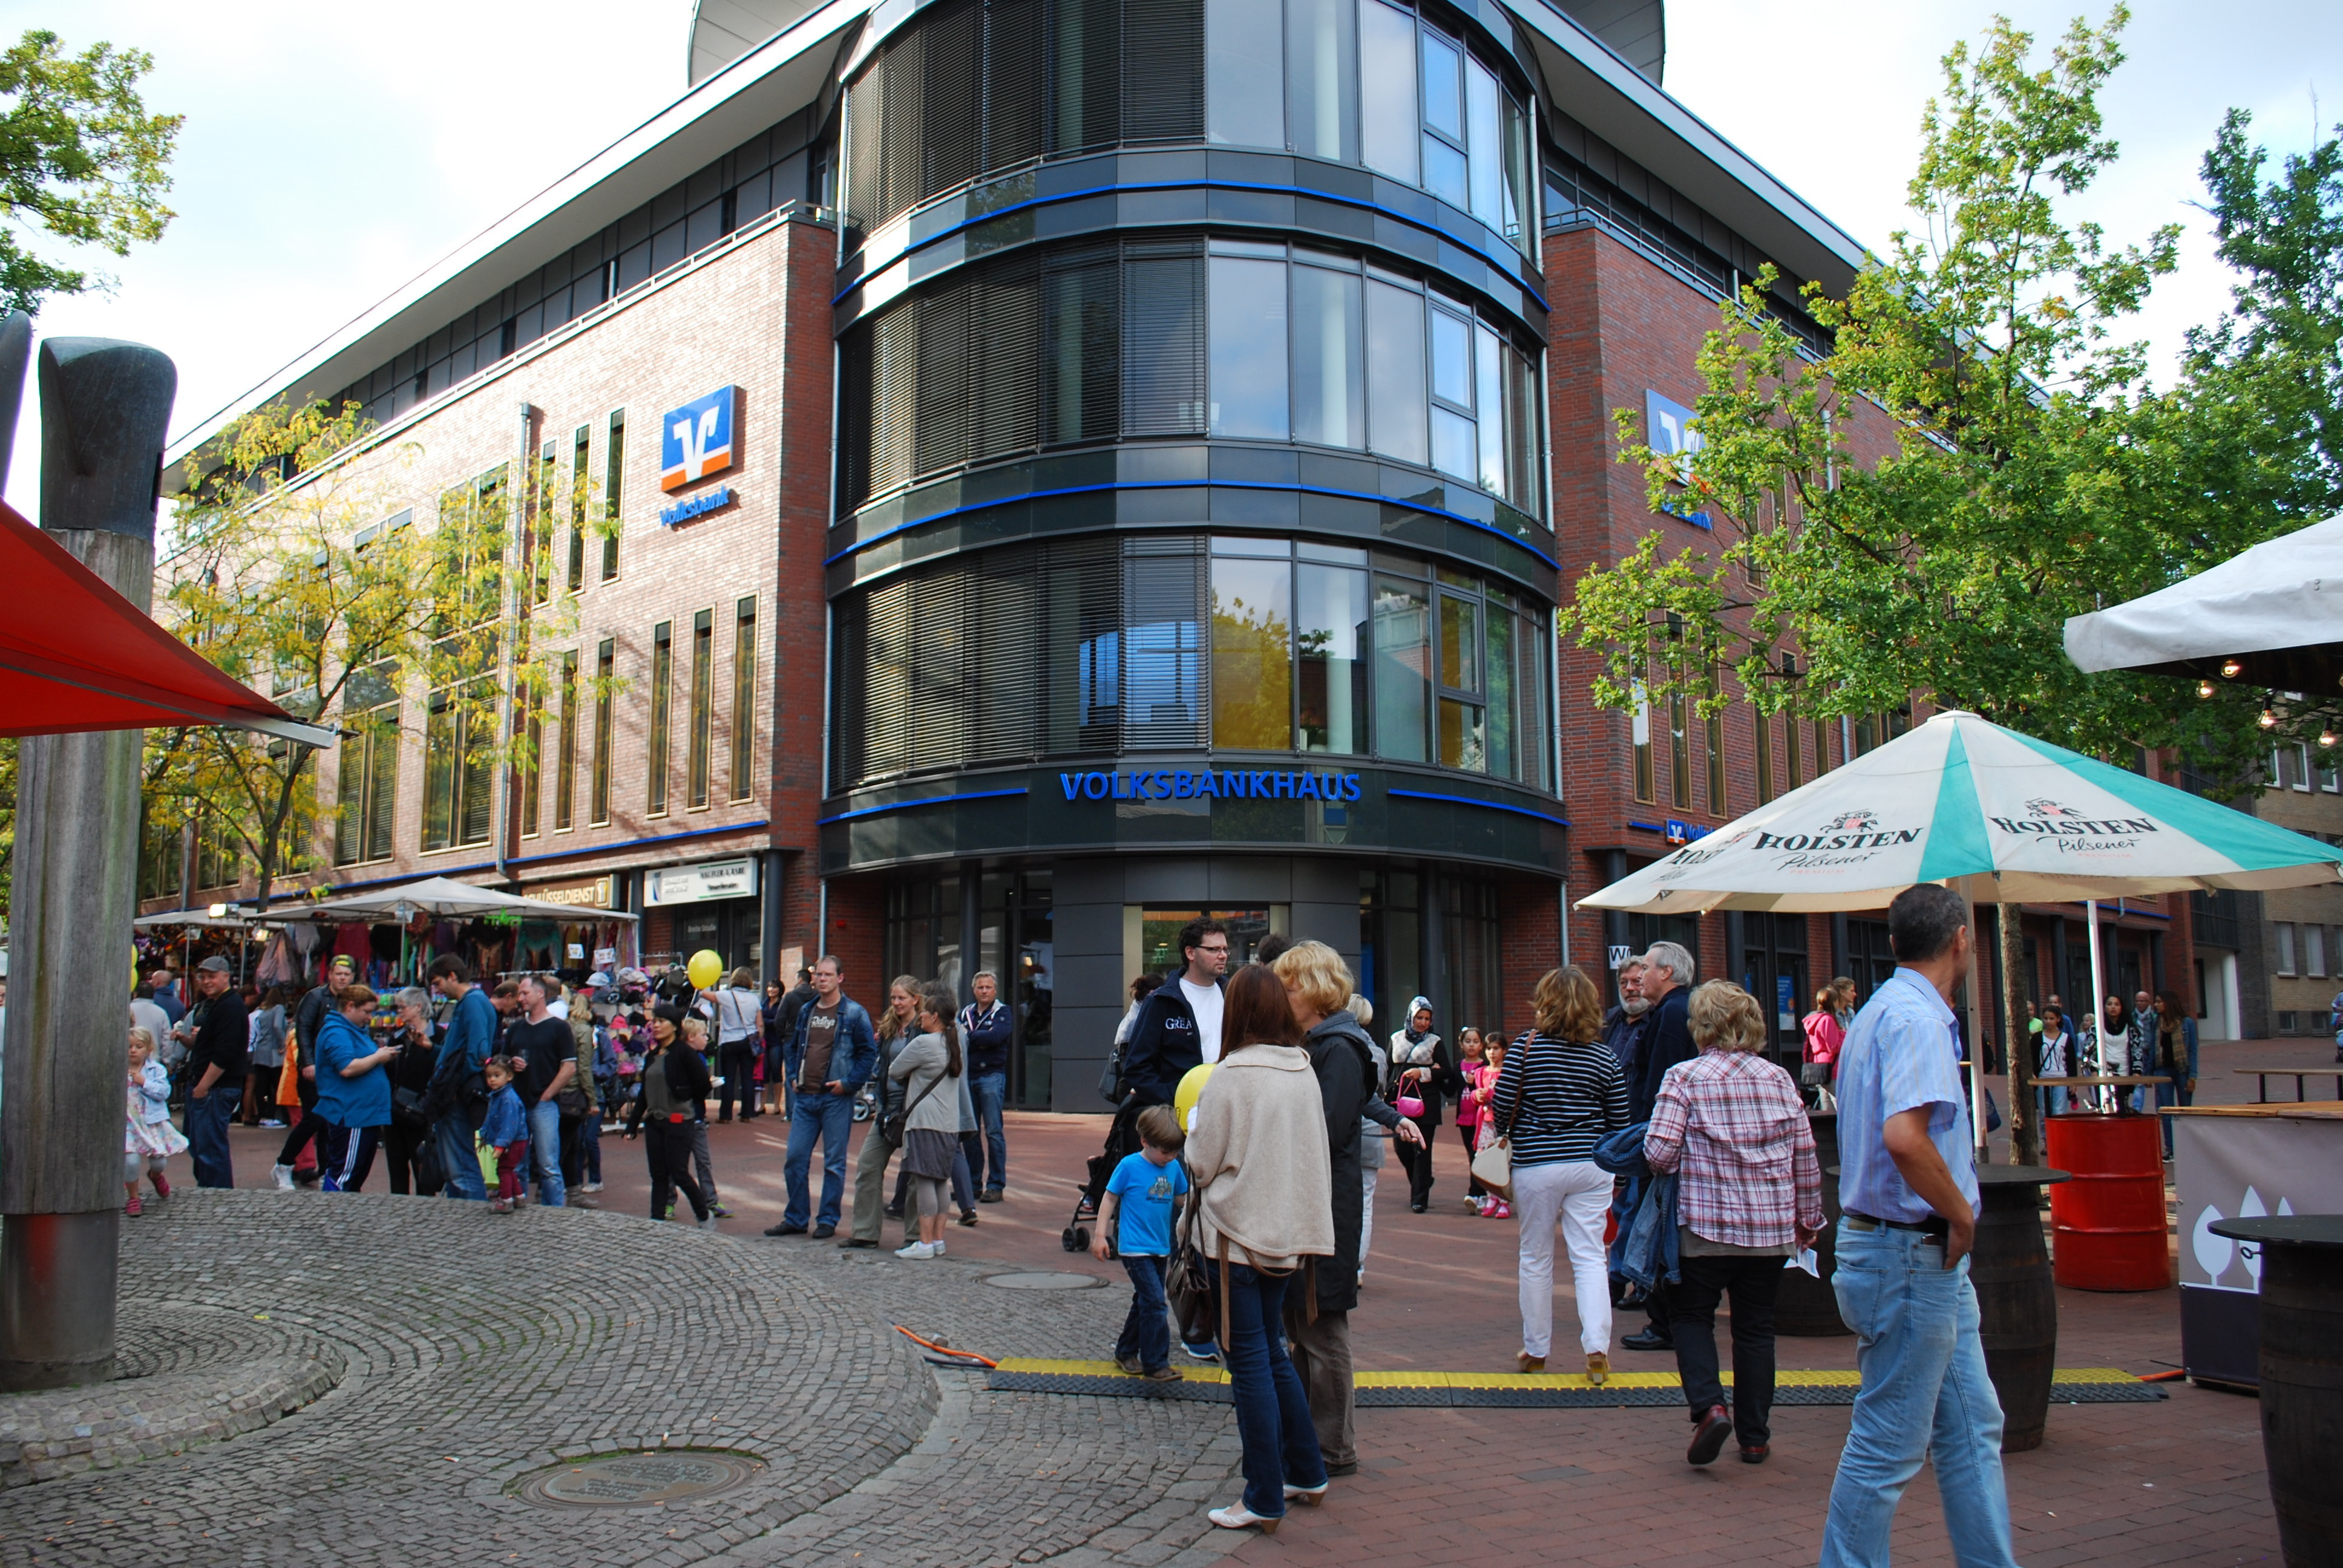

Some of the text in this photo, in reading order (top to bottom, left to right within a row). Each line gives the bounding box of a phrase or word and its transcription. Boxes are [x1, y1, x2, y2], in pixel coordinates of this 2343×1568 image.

[660, 485, 729, 526] Volksbank
[1060, 769, 1361, 801] VOLKSBANKHAUS
[1987, 815, 2158, 835] HOLSTEN
[1751, 828, 1924, 851] HOLSTEN
[2036, 836, 2141, 853] Pilsener
[1771, 851, 1883, 871] Pilsener
